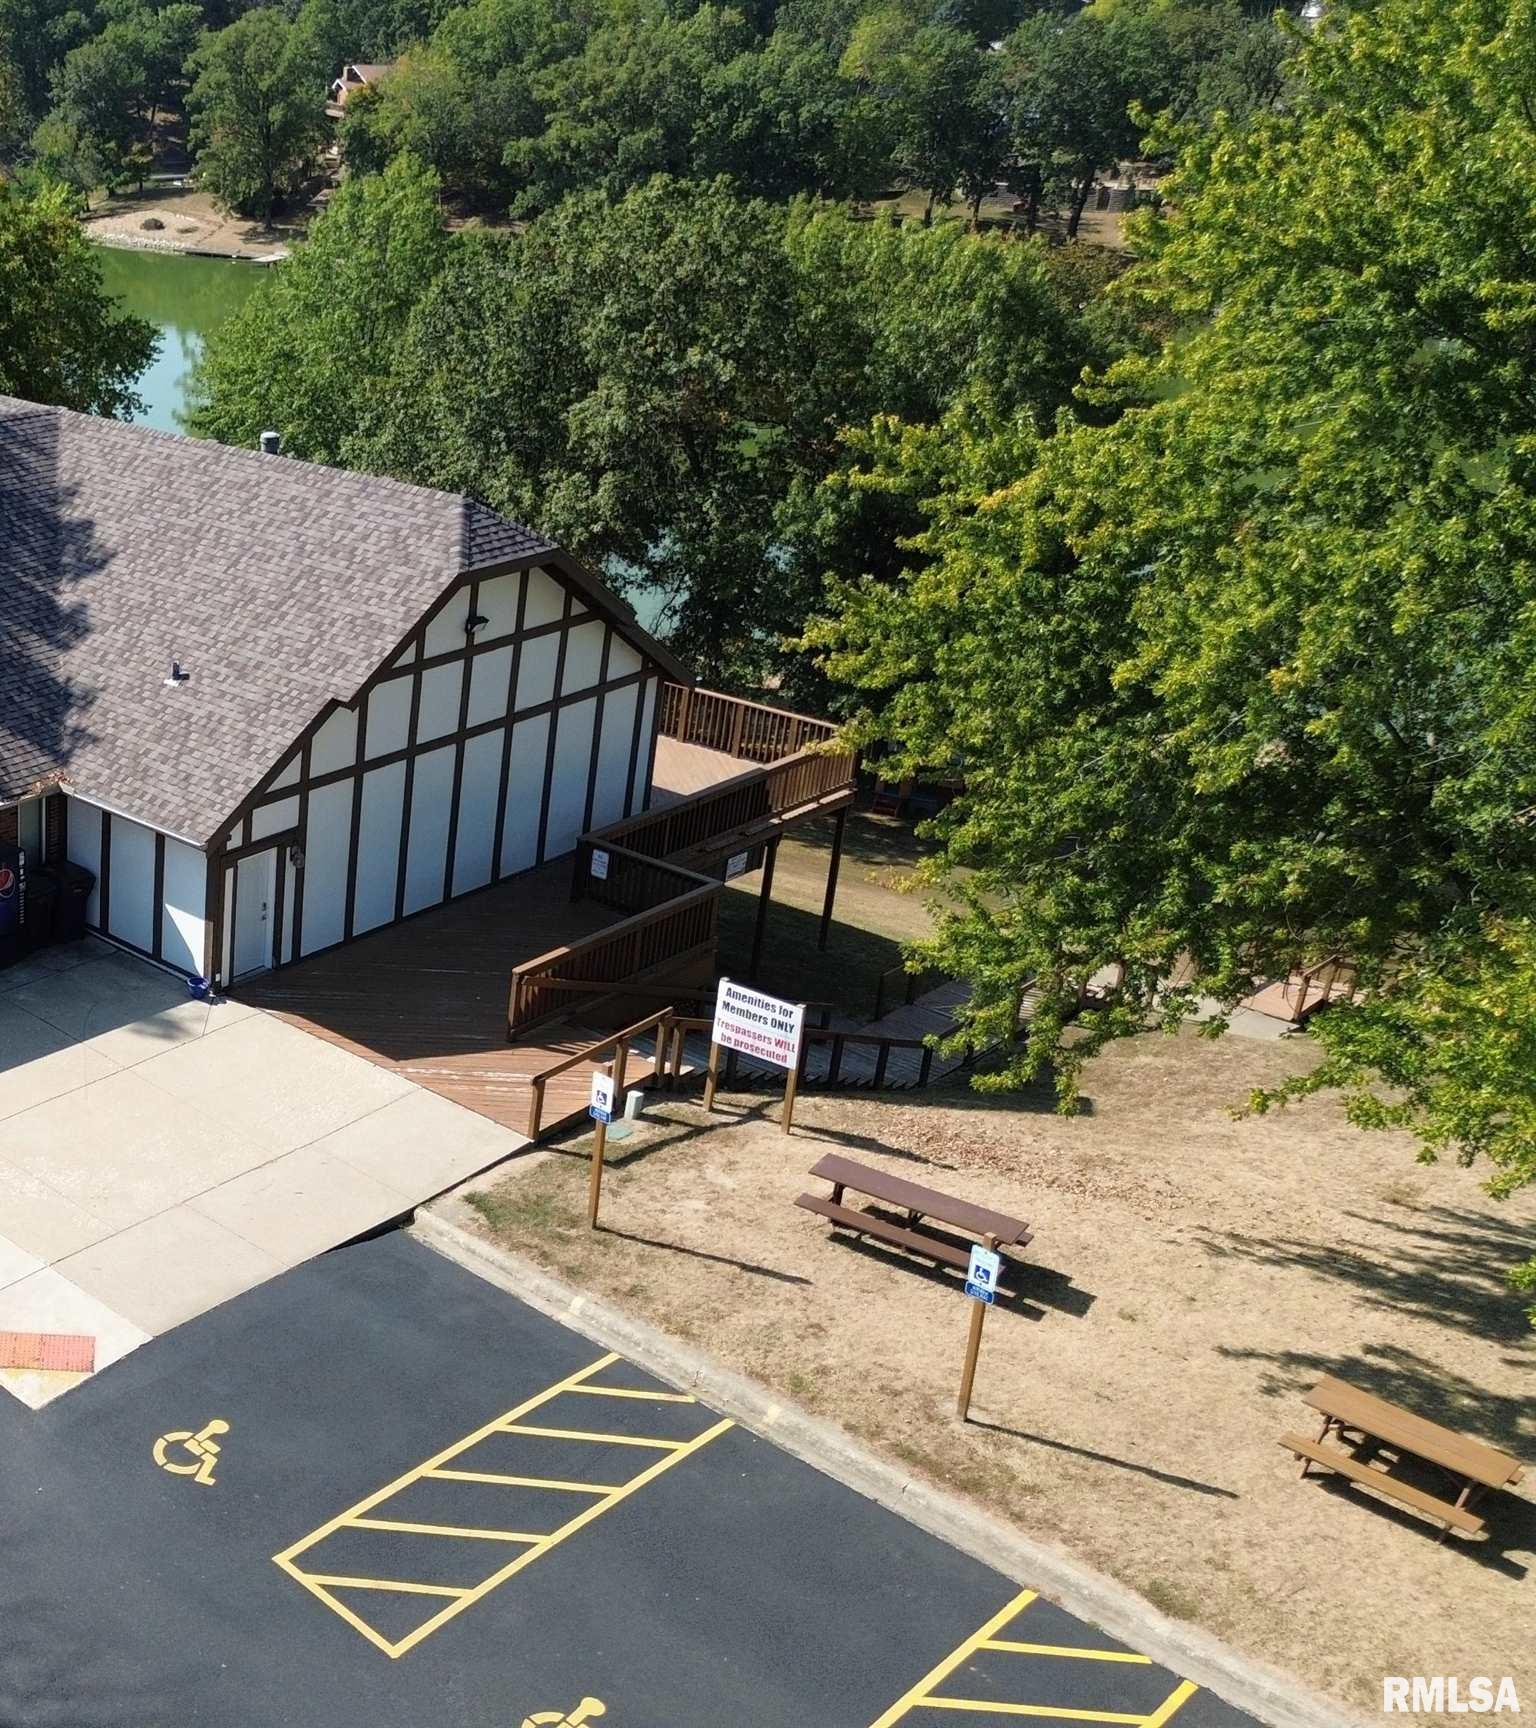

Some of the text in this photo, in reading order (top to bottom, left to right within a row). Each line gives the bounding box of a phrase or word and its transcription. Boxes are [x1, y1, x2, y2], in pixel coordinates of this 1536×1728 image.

[721, 1000, 795, 1034] Members ONLY
[725, 987, 794, 1019] Amenities for
[716, 1018, 796, 1053] Trespassers WILL
[720, 1032, 788, 1063] be prosecuted
